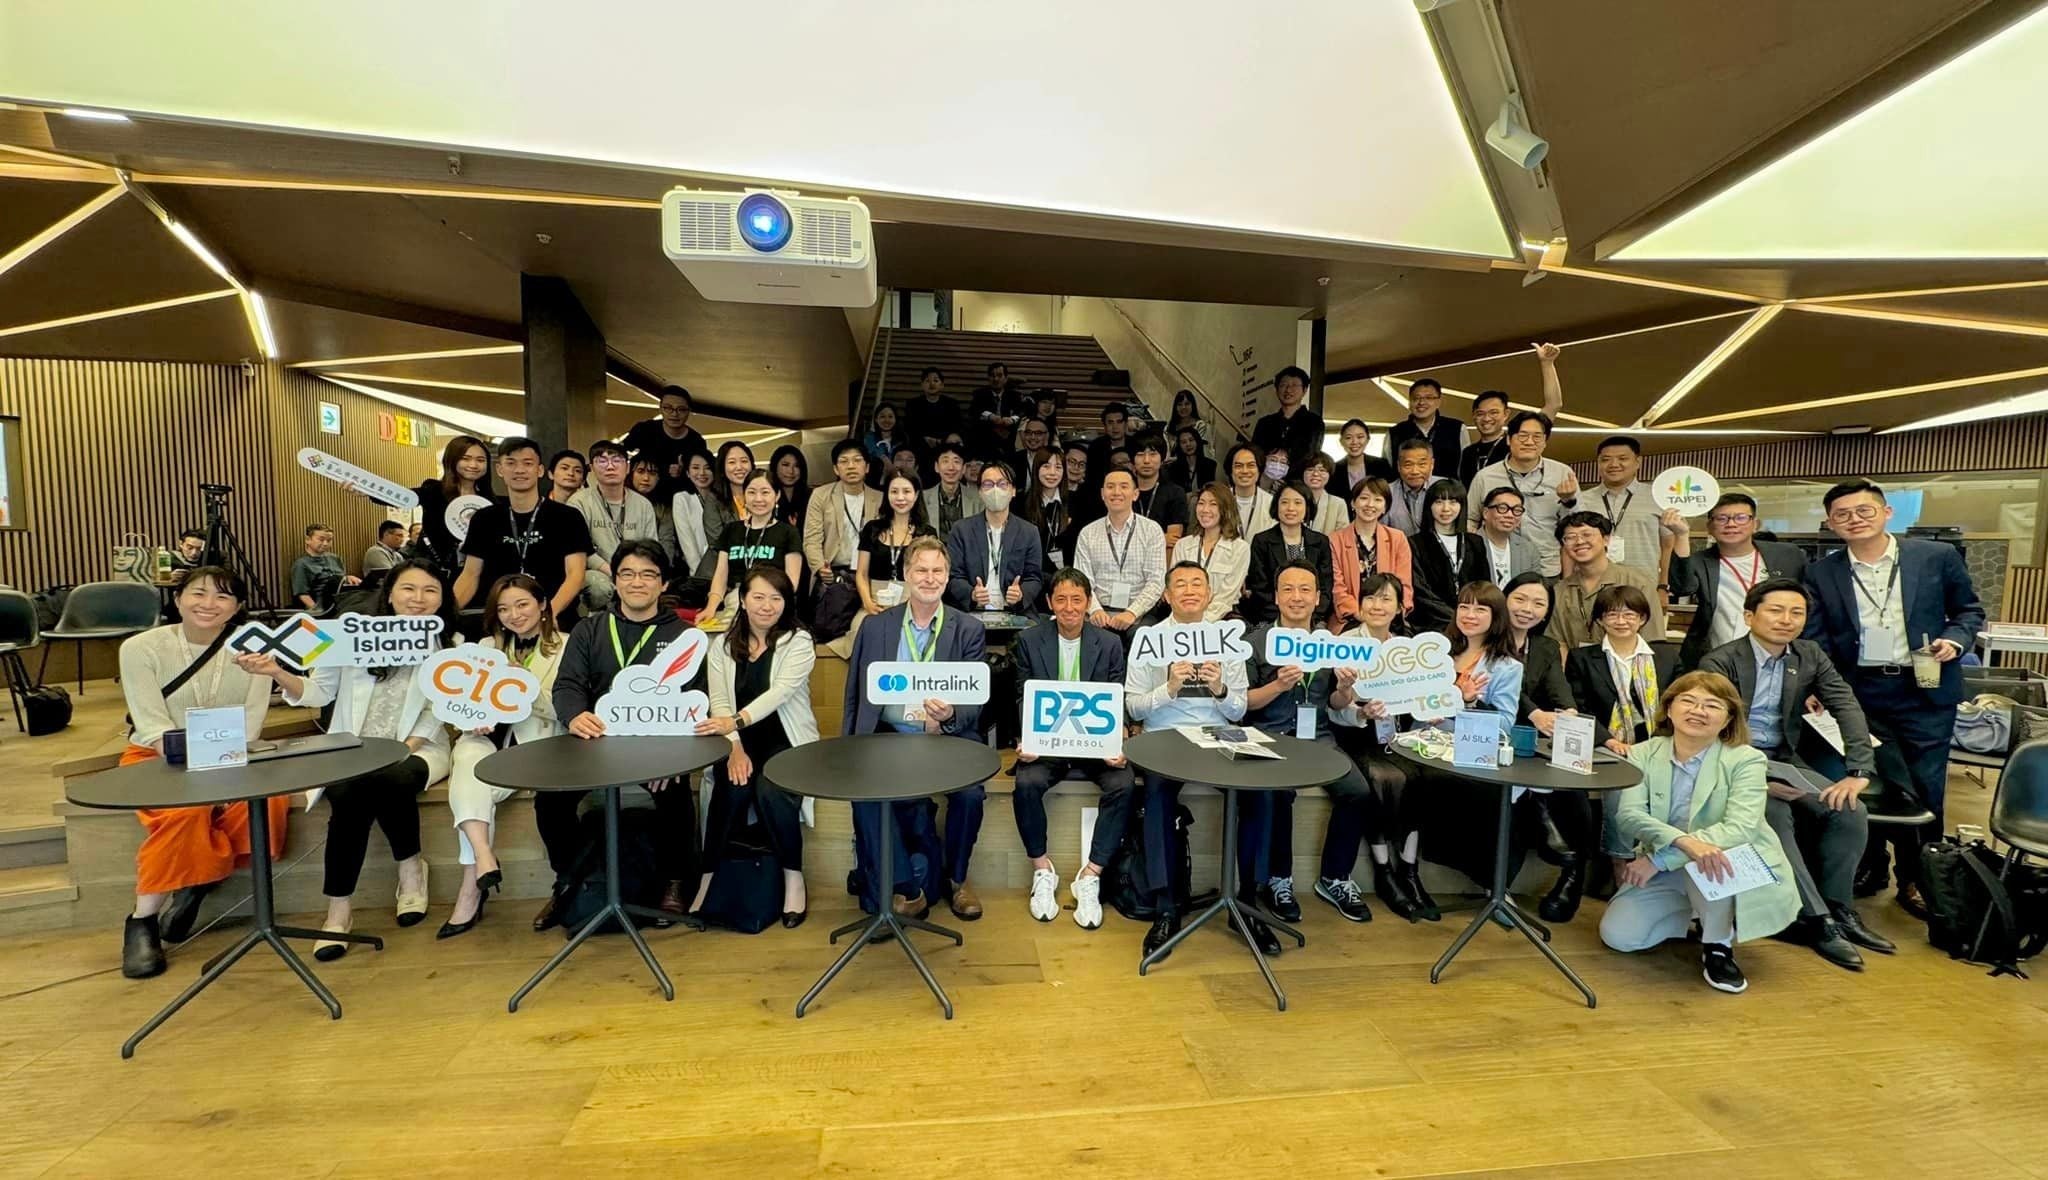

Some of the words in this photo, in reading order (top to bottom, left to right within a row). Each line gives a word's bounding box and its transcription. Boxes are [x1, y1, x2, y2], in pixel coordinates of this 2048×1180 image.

[1667, 495, 1707, 504] TAIPEI
[343, 617, 439, 637] Startup
[353, 634, 429, 653] Island
[1136, 633, 1165, 660] AI
[1174, 627, 1239, 657] SILK
[1274, 636, 1374, 663] Digirow
[354, 654, 430, 665] TAIWAN
[912, 674, 980, 692] Intralink
[1406, 675, 1426, 684] GOLD
[1427, 671, 1447, 680] CARD
[446, 700, 488, 721] tokyo
[1415, 692, 1454, 712] TGC
[610, 704, 700, 723] STORIA
[1033, 690, 1116, 735] BRS
[1039, 738, 1049, 748] by
[1062, 738, 1104, 748] PERSOL
[1461, 733, 1471, 742] AI
[1472, 734, 1492, 744] SILK
